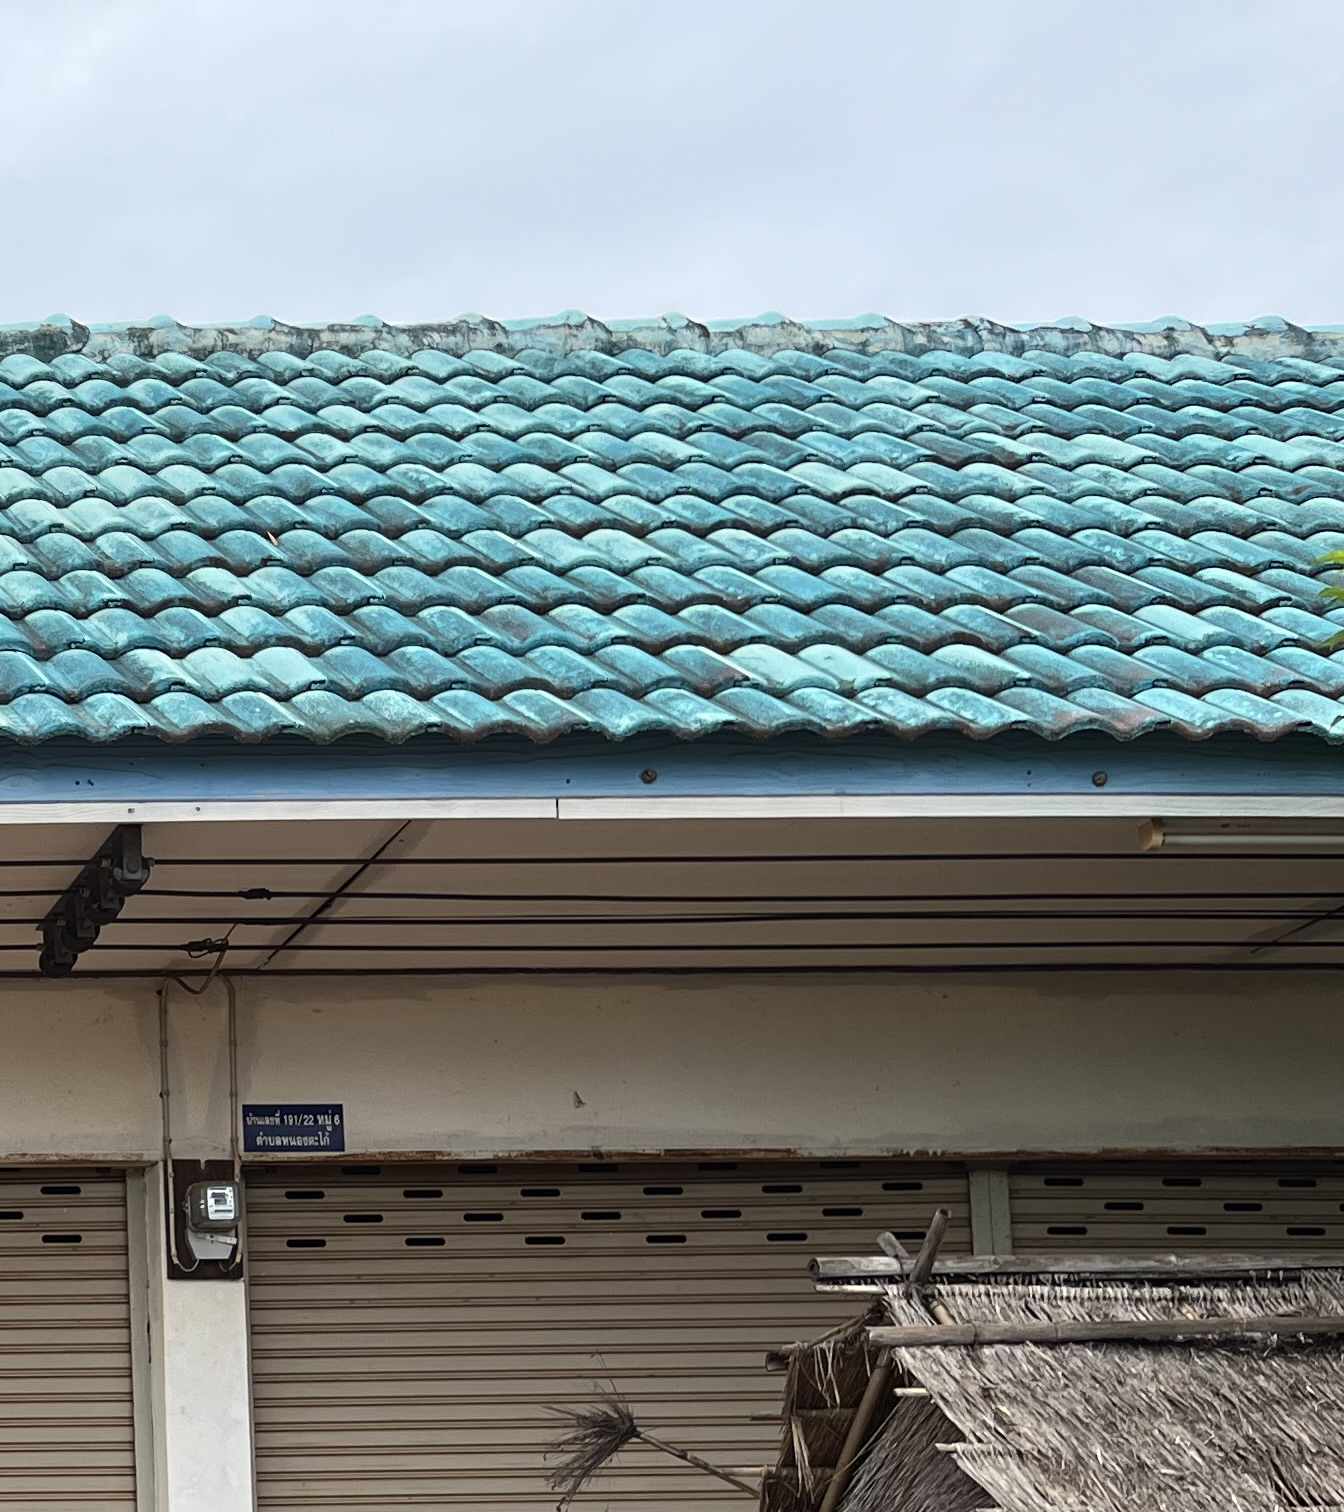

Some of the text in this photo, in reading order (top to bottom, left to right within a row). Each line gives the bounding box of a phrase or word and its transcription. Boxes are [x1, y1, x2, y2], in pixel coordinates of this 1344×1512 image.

[283, 1114, 314, 1126] 191/22
[316, 1109, 332, 1131] หมู่
[334, 1114, 340, 1125] 6
